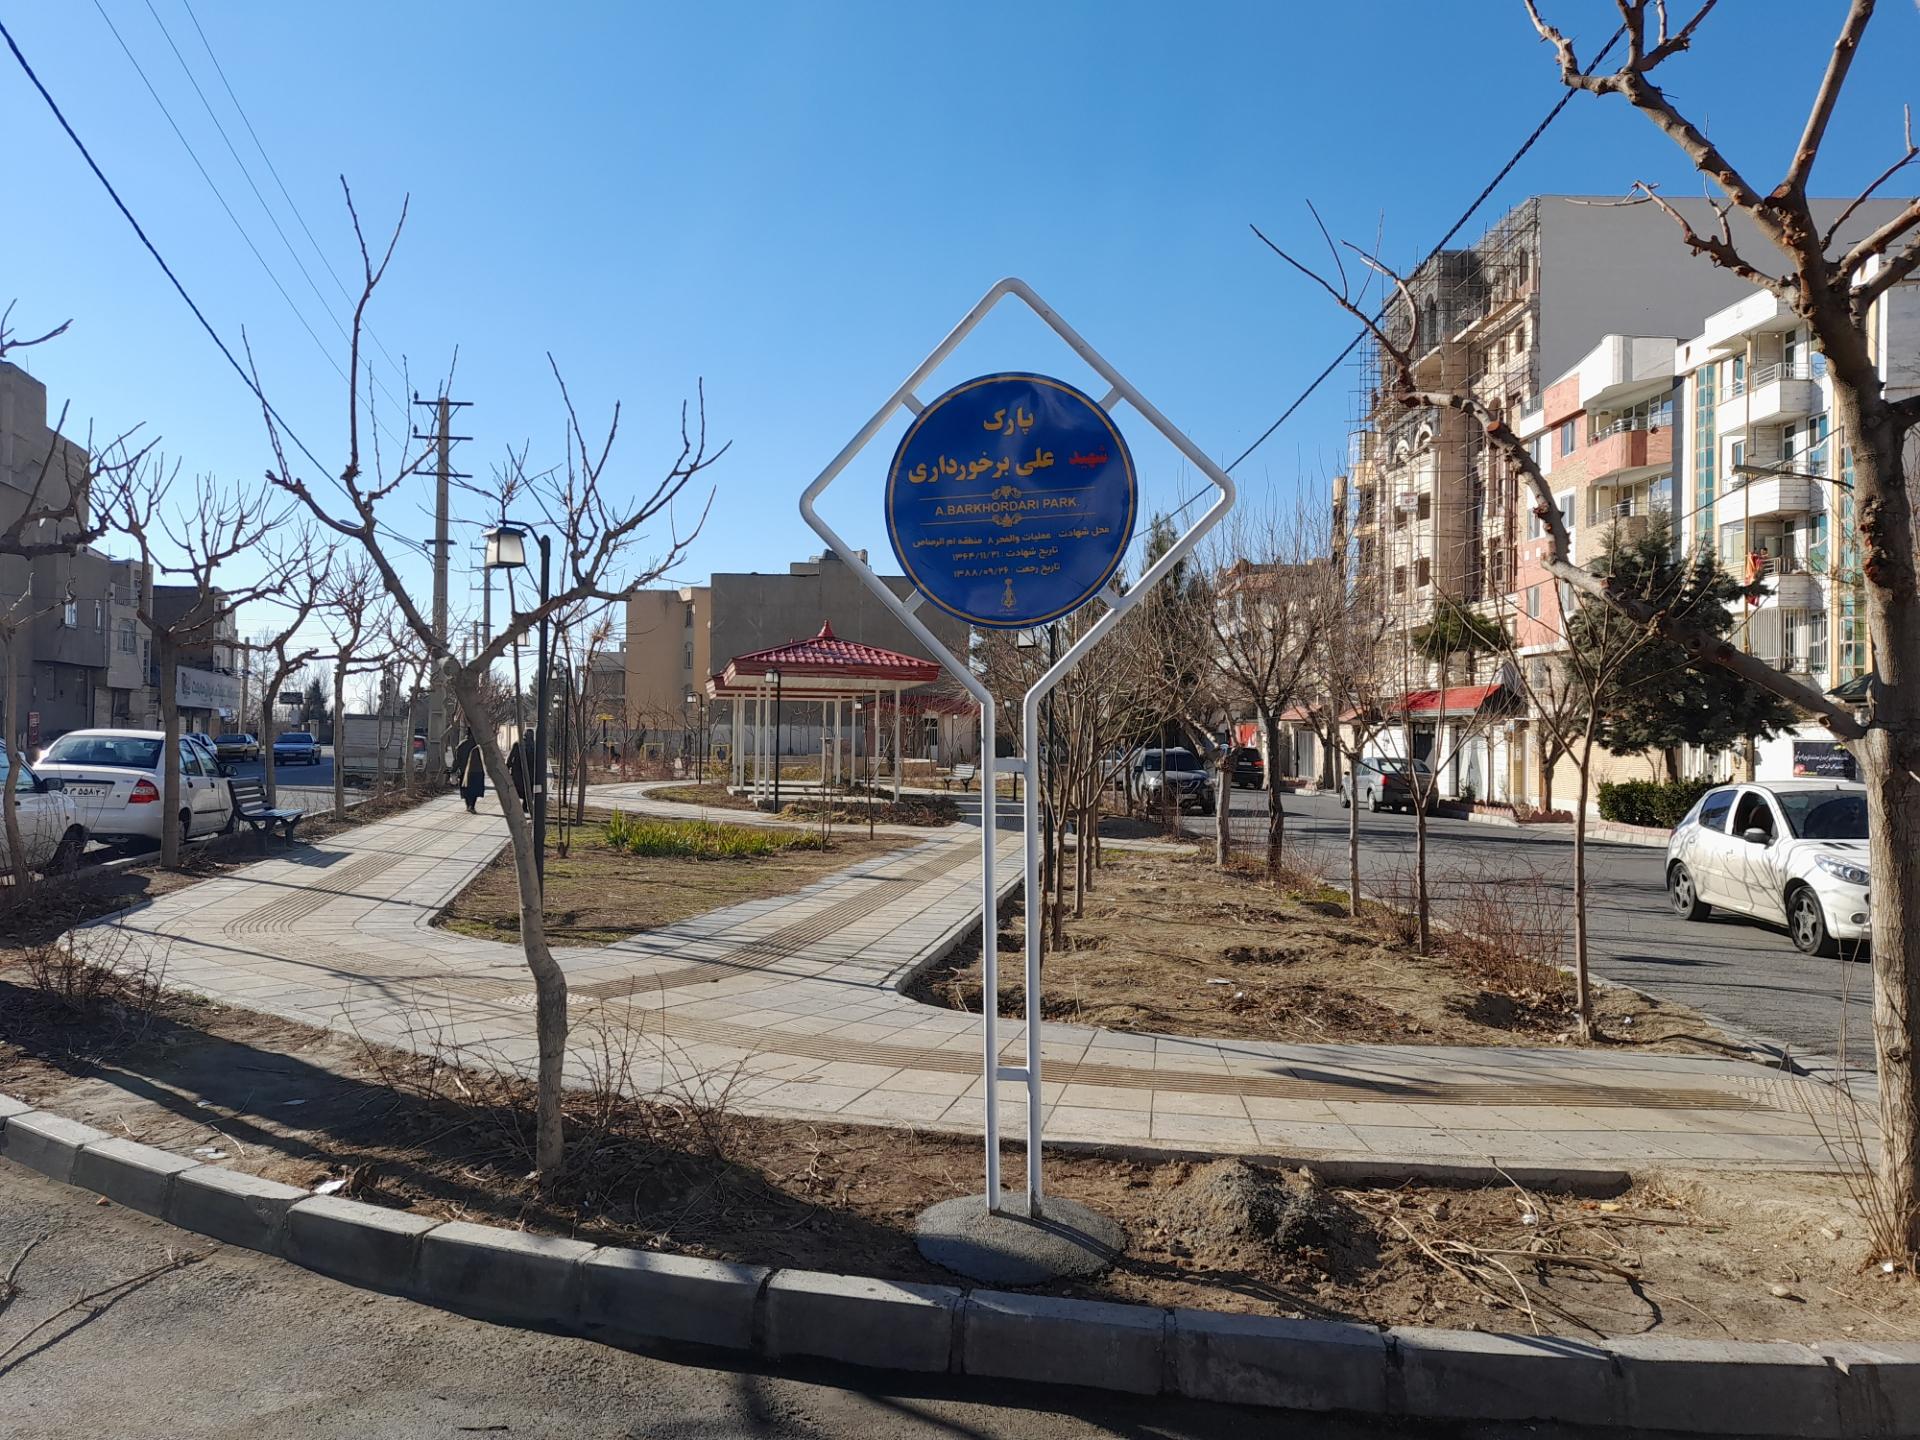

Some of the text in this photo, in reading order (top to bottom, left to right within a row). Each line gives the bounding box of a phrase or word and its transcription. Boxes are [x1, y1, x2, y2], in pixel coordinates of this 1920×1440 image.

[983, 407, 1034, 435] پارک
[908, 451, 1010, 483] برخورداری
[1015, 448, 1054, 476] علی
[935, 501, 1040, 516] A.BARKHORDARI
[1091, 527, 1110, 536] محل
